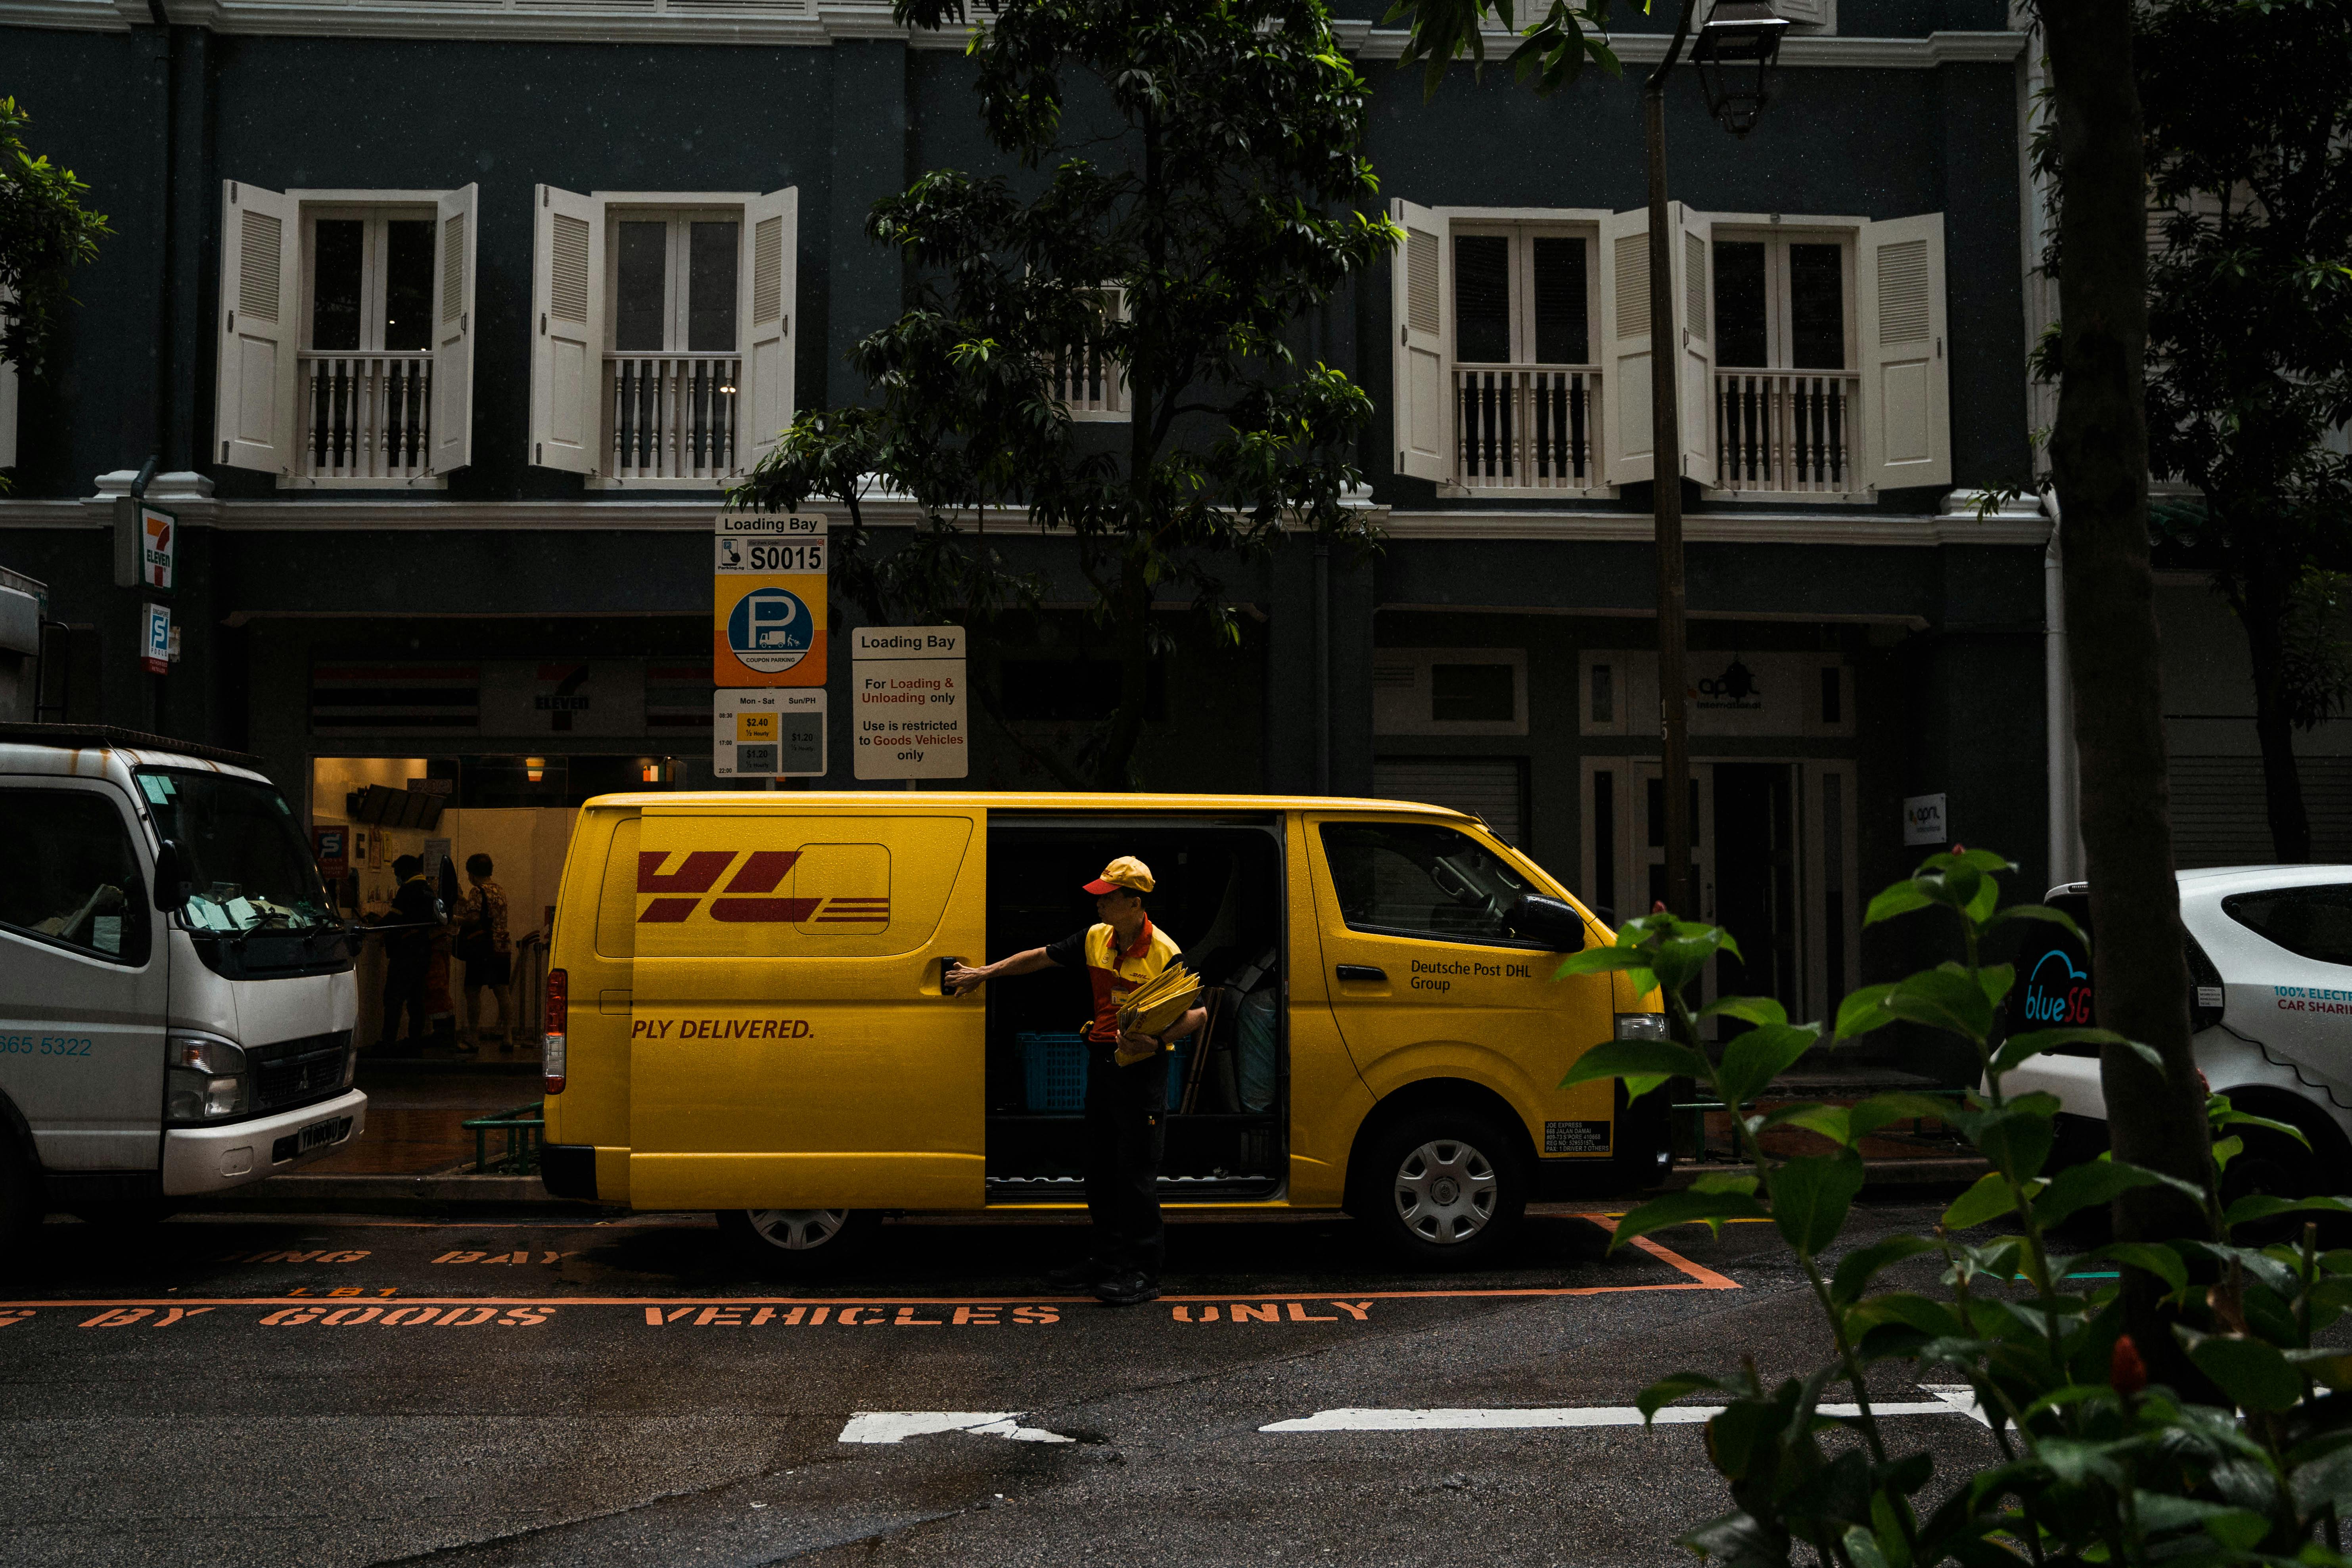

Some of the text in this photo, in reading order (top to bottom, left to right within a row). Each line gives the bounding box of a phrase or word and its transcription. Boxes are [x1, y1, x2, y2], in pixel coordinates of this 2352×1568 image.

[725, 518, 818, 533] Loading Bay
[751, 546, 821, 569] S0015
[861, 635, 956, 651] Loading Bay
[151, 647, 167, 657] POOLS
[865, 678, 954, 690] For Loading &
[862, 693, 955, 705] Unloading only
[746, 718, 768, 727] $2.40
[863, 720, 957, 731] Use is restricted
[859, 734, 964, 746] to Goods Vehicles
[746, 750, 768, 759] $1.20
[897, 749, 924, 762] only
[1411, 960, 1532, 978] Deutsche Post DHL
[1411, 976, 1450, 993] Group
[2274, 985, 2305, 998] 100%
[2025, 984, 2092, 1025] blueSG
[2277, 999, 2305, 1011] CAR
[632, 1020, 815, 1039] PLY DELIVERED.
[40, 1037, 92, 1056] 5322
[431, 1250, 583, 1264] BAY
[77, 1307, 217, 1327] BY
[259, 1307, 556, 1326] GOODS
[645, 1306, 1061, 1326] VEHICLES
[1171, 1302, 1374, 1322] ONLY
